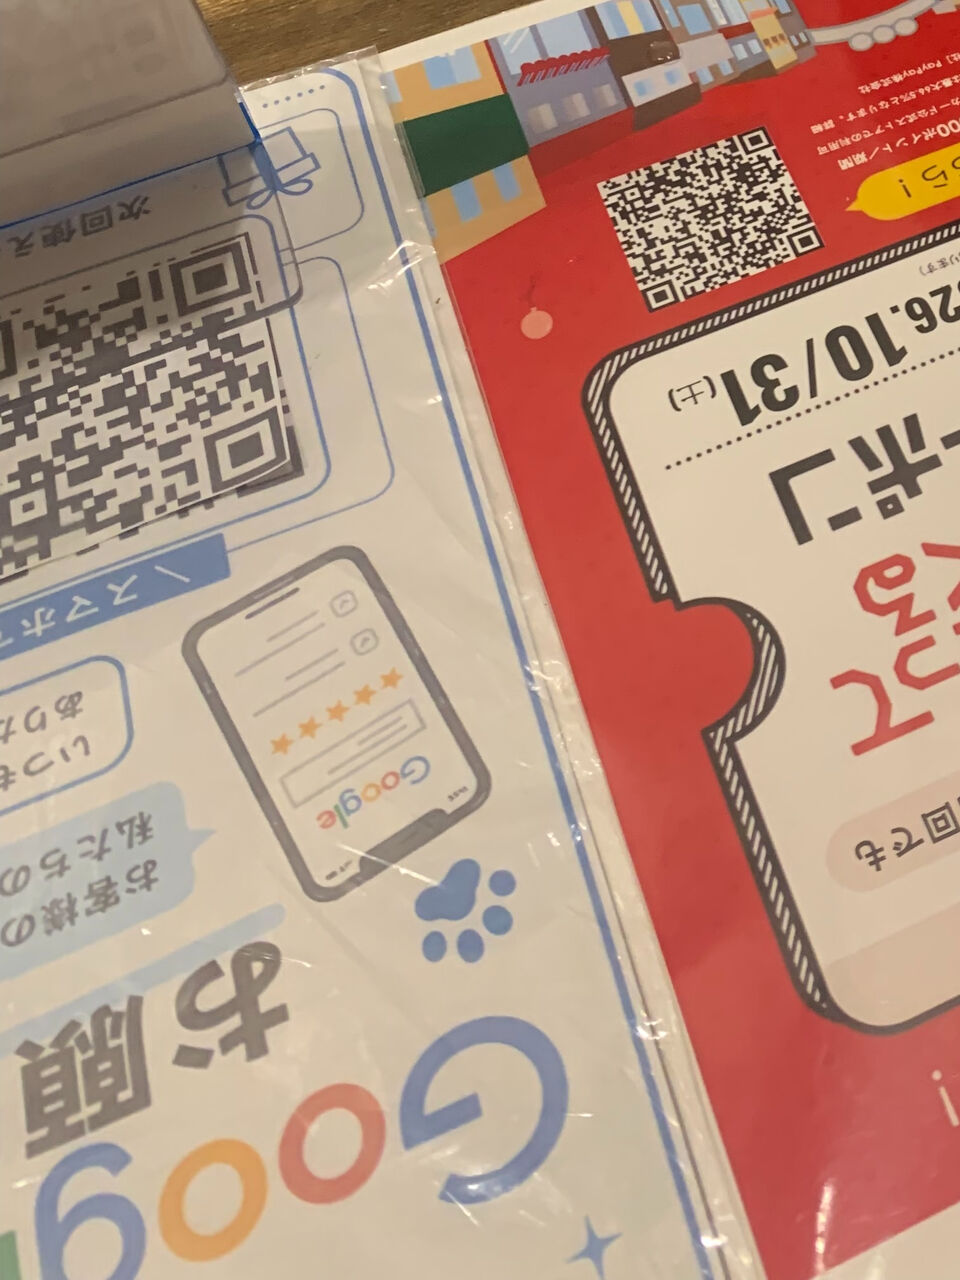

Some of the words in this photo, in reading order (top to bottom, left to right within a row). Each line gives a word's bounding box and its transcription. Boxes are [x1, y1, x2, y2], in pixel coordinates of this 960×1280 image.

[5, 195, 152, 260] 次回使え
[316, 756, 432, 830] Google
[0, 810, 155, 898] 私たちの
[0, 859, 158, 949] お客様の
[14, 941, 290, 1160] お願
[0, 1016, 570, 1280] Goog
